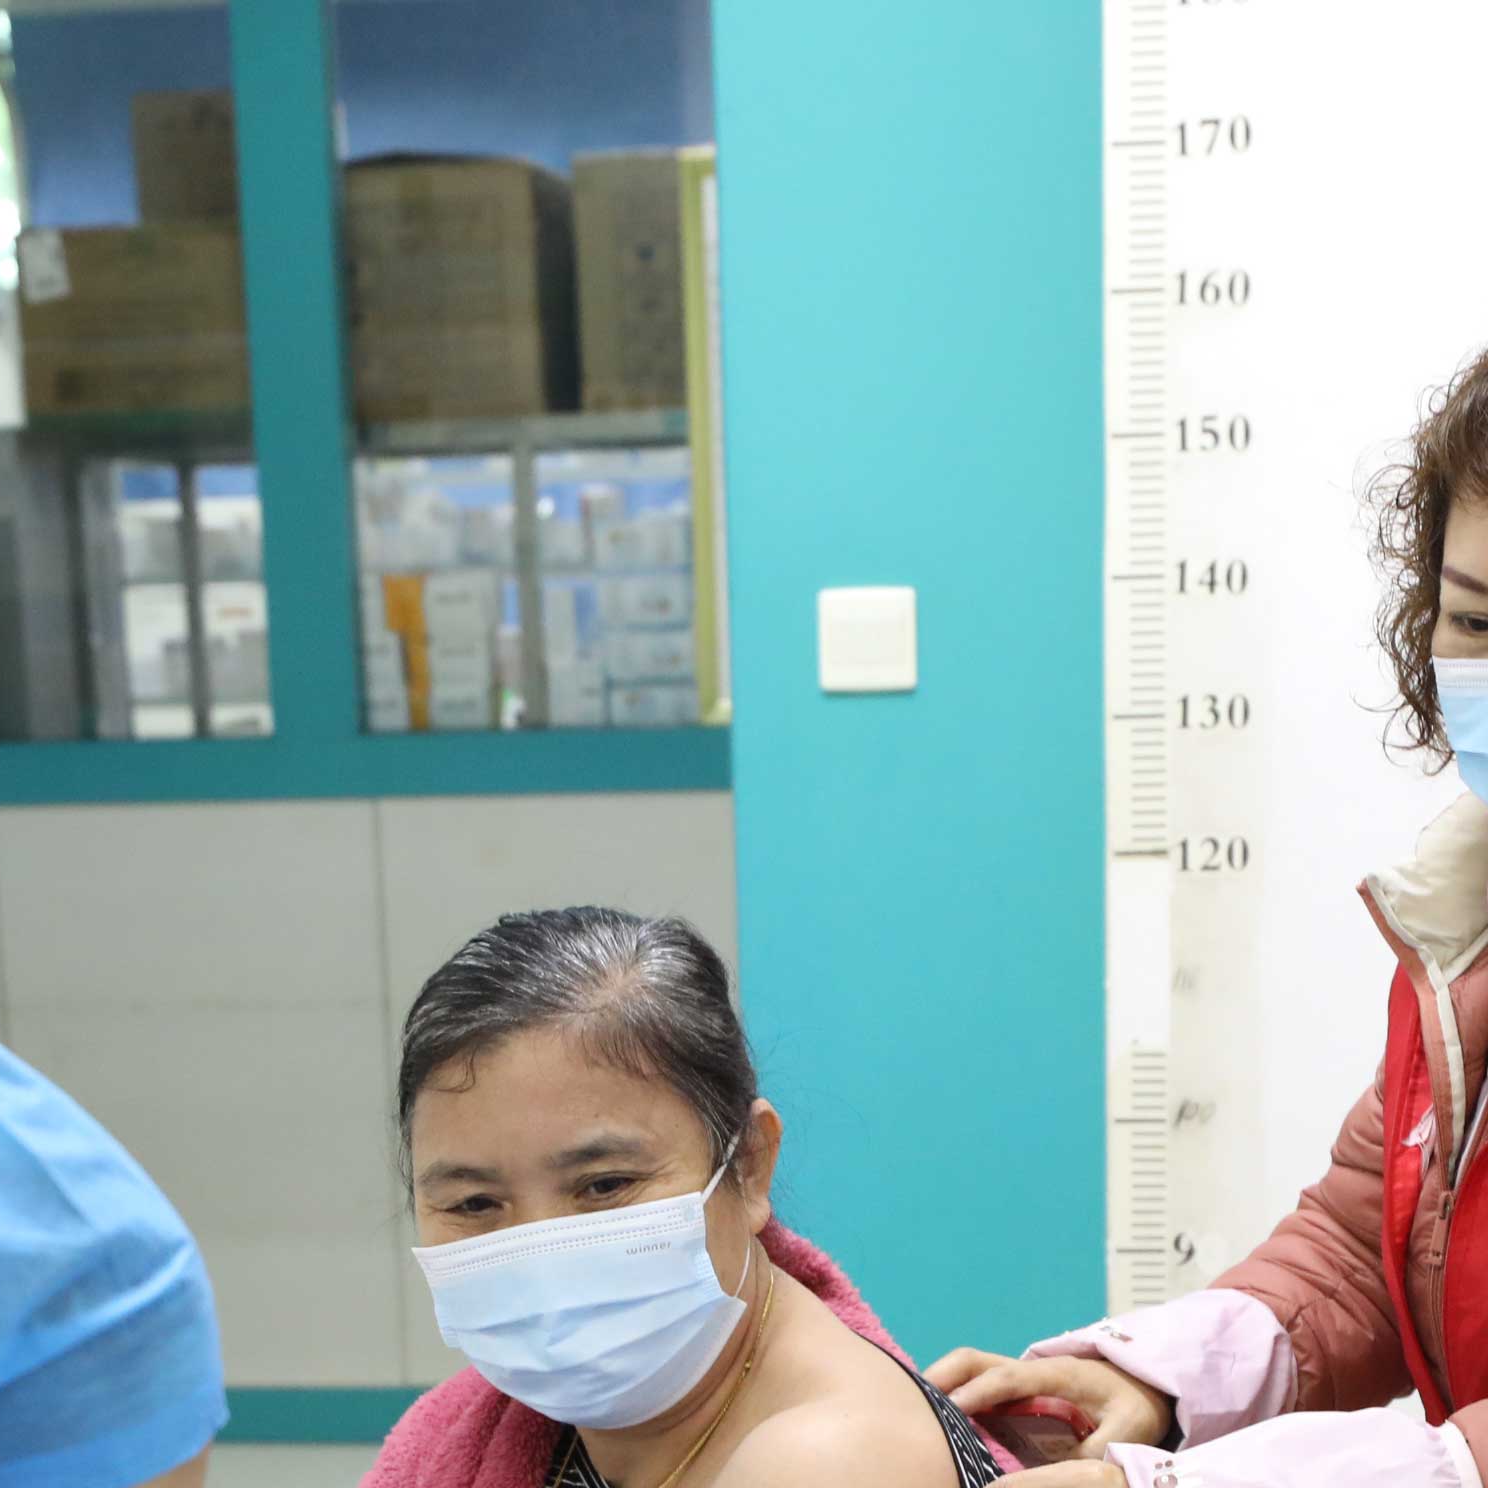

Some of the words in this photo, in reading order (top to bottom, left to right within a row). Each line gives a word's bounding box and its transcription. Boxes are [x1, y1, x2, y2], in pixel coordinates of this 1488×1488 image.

[1175, 116, 1252, 157] 170
[1175, 269, 1251, 306] 160
[1175, 414, 1252, 453] 150
[1174, 559, 1250, 596] 140
[1176, 693, 1251, 730] 130
[1176, 836, 1250, 873] 120
